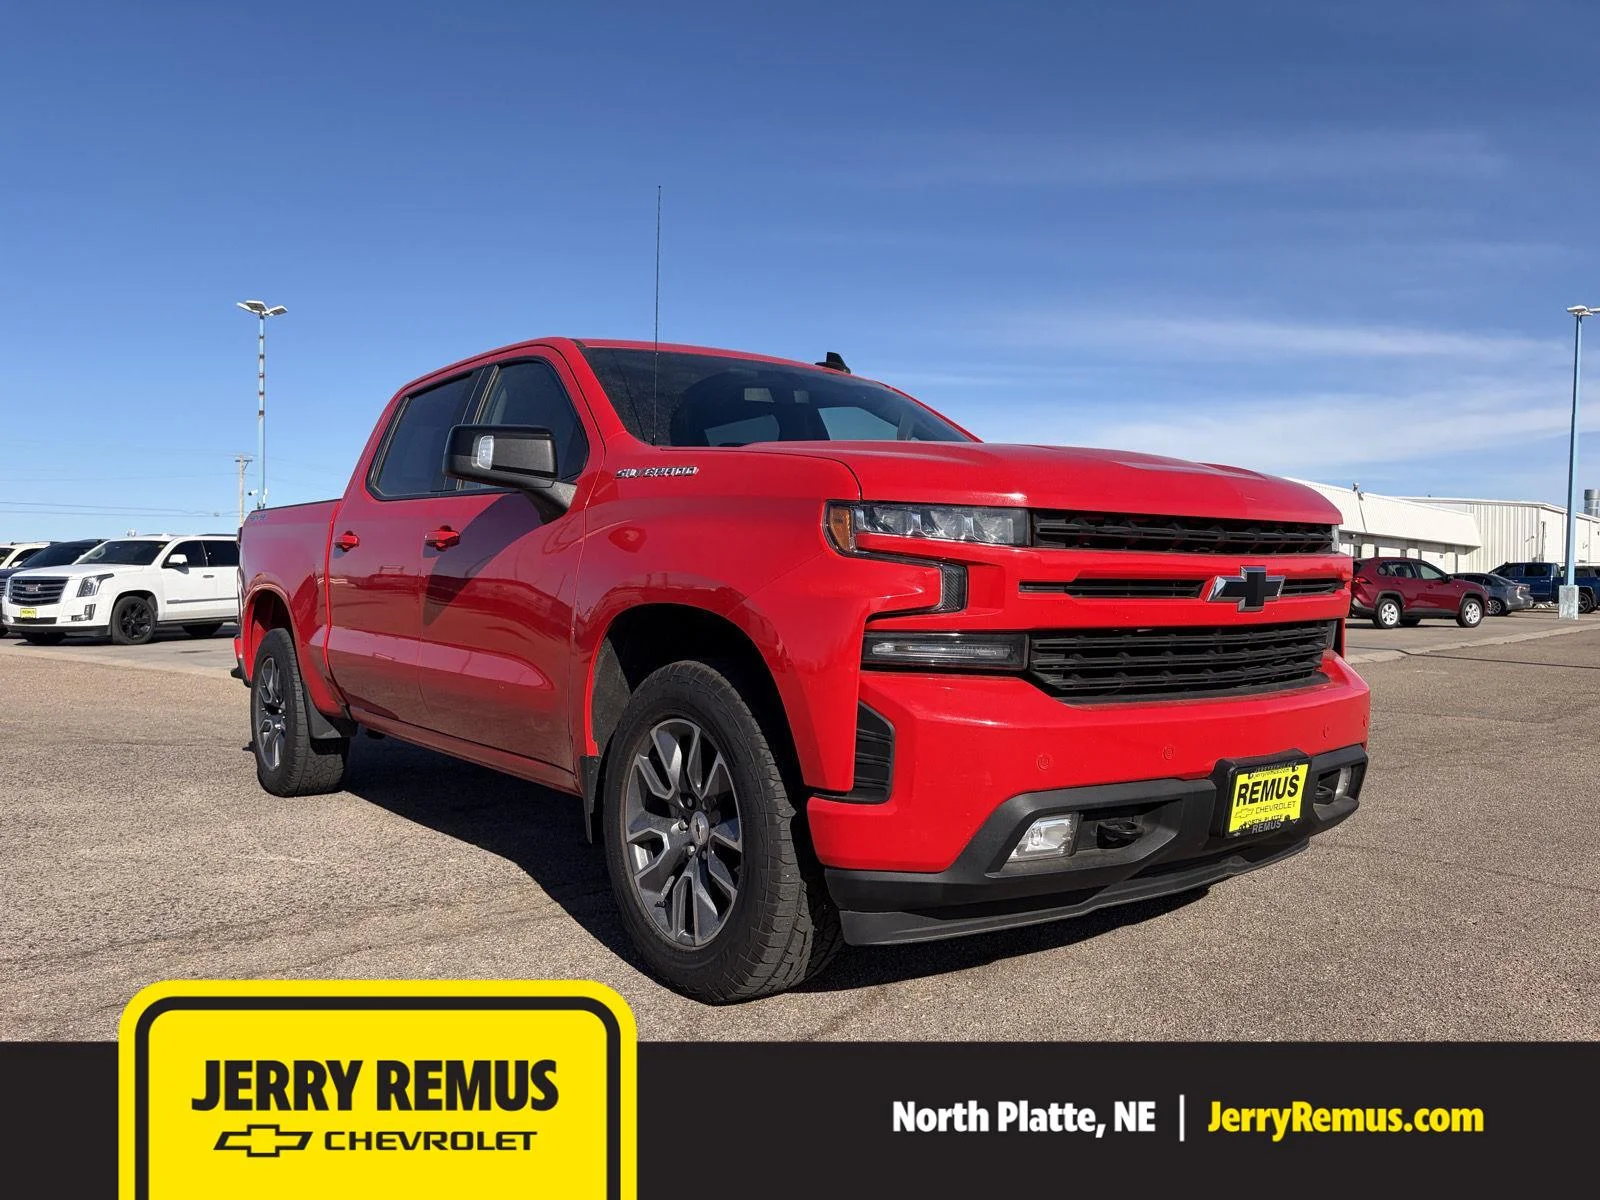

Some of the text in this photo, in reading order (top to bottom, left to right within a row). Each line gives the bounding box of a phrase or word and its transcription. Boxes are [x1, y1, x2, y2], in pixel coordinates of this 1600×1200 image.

[1236, 775, 1300, 807] REMUS
[1255, 800, 1297, 814] CHEVROLET
[1252, 821, 1282, 833] REMUS
